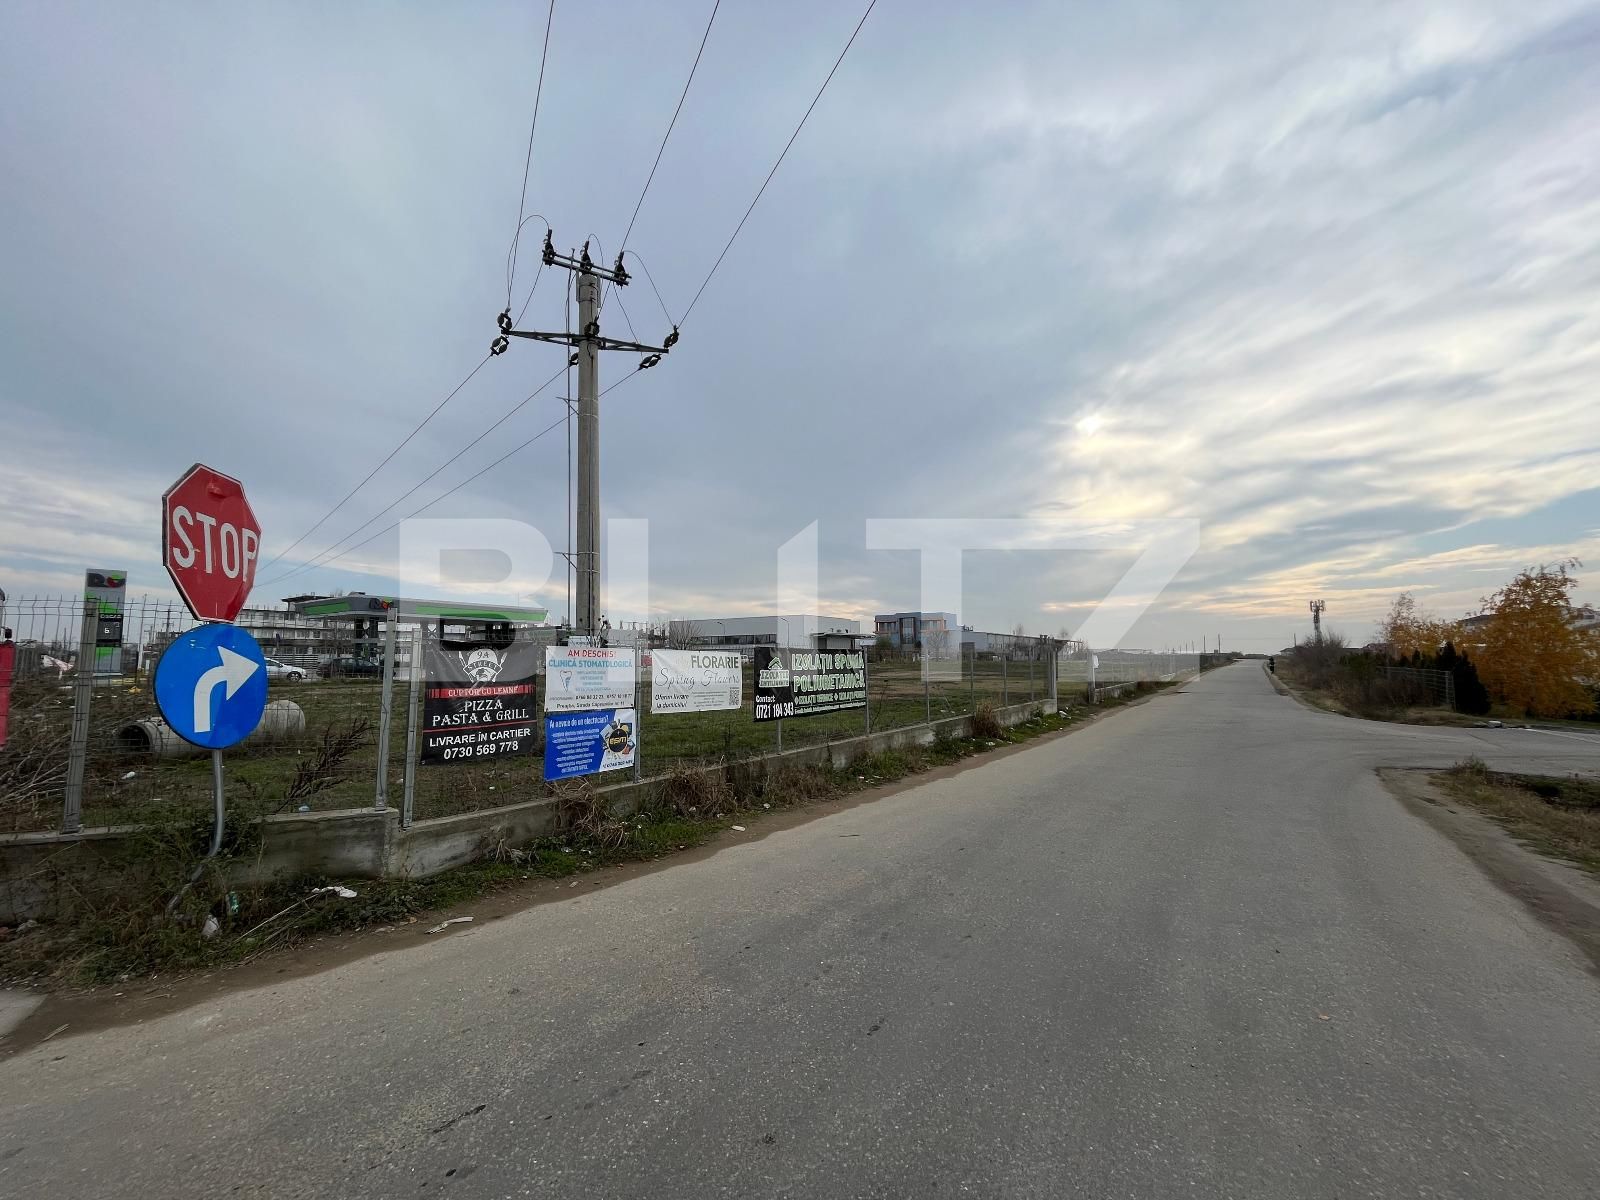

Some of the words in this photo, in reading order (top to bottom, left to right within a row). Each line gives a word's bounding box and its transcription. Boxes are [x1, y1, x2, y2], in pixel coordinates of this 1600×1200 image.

[172, 505, 258, 582] STOP
[567, 649, 580, 657] AM
[690, 655, 739, 668] FLORARIE
[834, 651, 865, 670] SPUMĂ
[654, 667, 695, 690] Spring
[701, 669, 739, 686] Flowers
[793, 670, 866, 693] POLIURETANICĂ
[448, 688, 480, 697] CUPTOR
[481, 688, 491, 696] CU
[493, 686, 519, 695] LEMNE
[755, 695, 776, 703] Contact
[464, 699, 503, 711] PIZZA
[756, 704, 771, 719] 0721
[773, 702, 783, 717] 184
[784, 702, 794, 717] 343
[432, 712, 478, 726] PASTA
[483, 711, 492, 722] &
[496, 708, 529, 721] GRILL
[429, 734, 476, 747] LIVRARE
[490, 728, 531, 741] CARTIER
[443, 746, 473, 759] 0730
[476, 743, 496, 756] 569
[499, 740, 519, 752] 778
